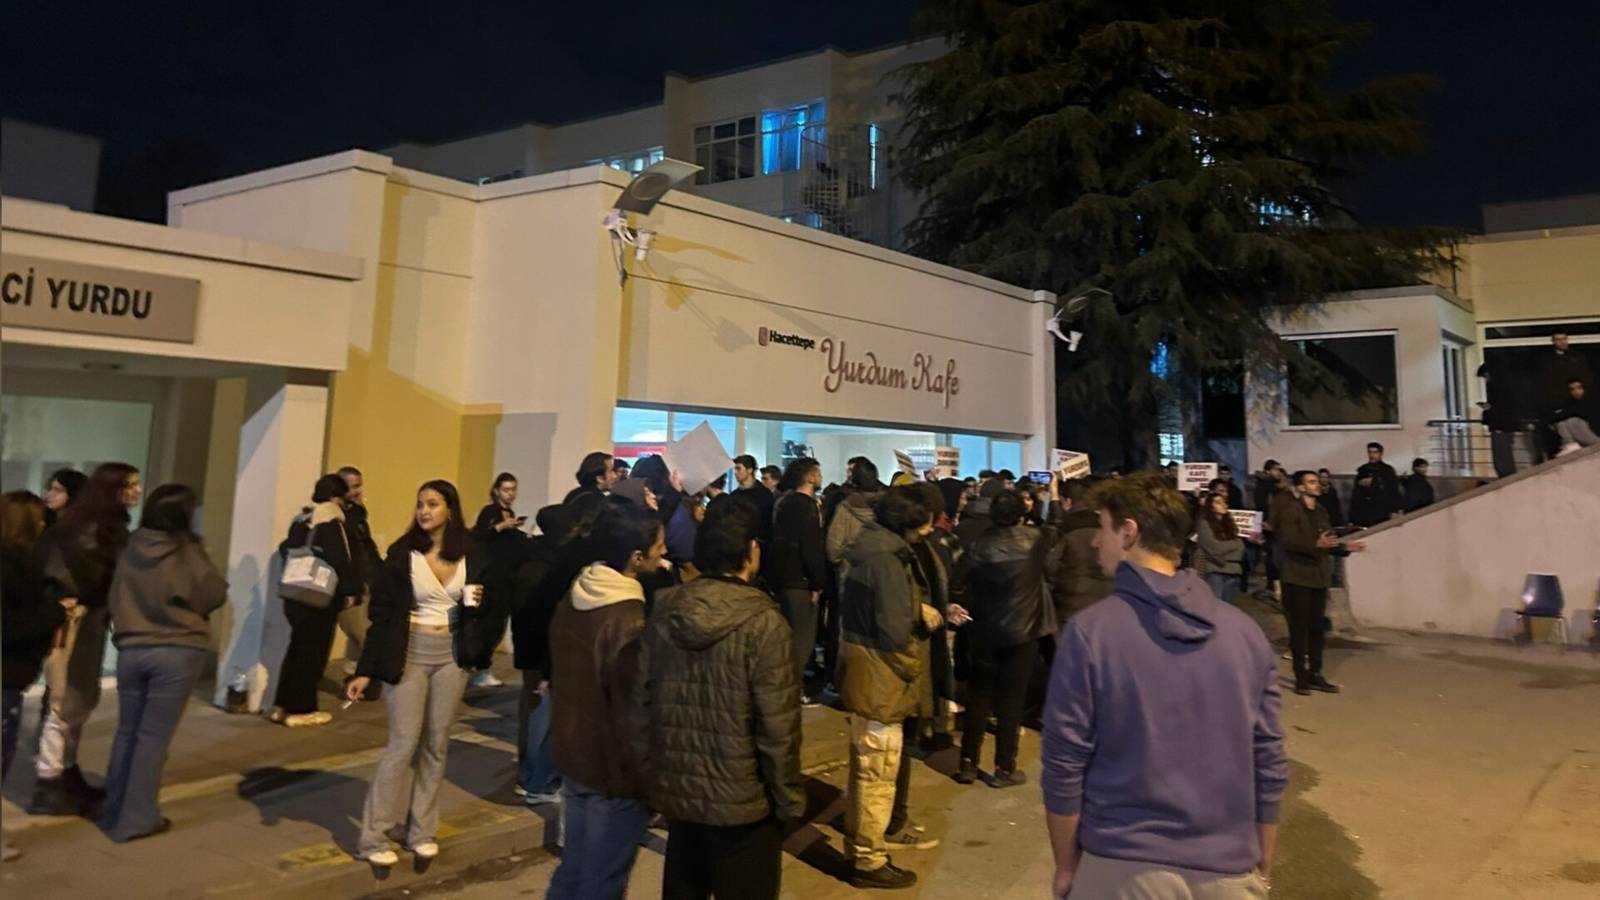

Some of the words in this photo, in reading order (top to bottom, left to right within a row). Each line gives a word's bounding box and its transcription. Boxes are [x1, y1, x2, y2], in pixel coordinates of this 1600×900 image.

[47, 277, 152, 320] YURDU
[769, 329, 815, 350] Hacettepe
[820, 337, 908, 393] Yurdum
[911, 352, 960, 409] Kafe
